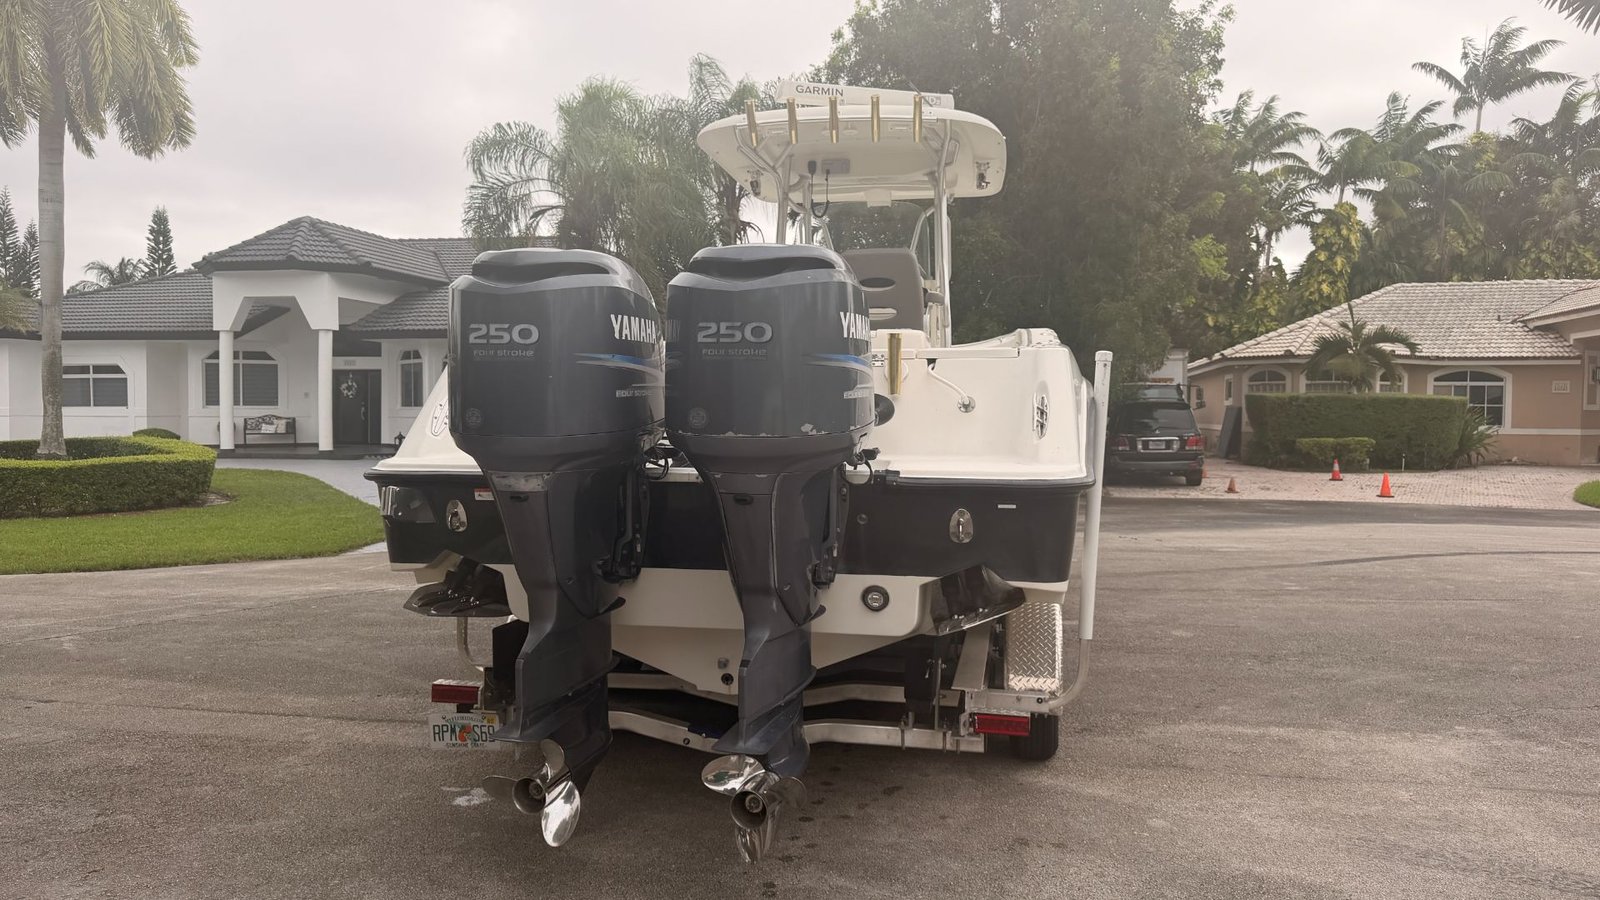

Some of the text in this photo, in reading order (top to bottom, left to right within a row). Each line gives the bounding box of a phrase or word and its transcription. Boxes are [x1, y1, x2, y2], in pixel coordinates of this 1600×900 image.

[795, 84, 844, 97] GARMIN
[468, 323, 539, 344] 250
[610, 313, 657, 344] YAMAHA
[697, 321, 773, 343] 250
[839, 311, 871, 342] YAMAH
[432, 724, 496, 742] RPM S69
